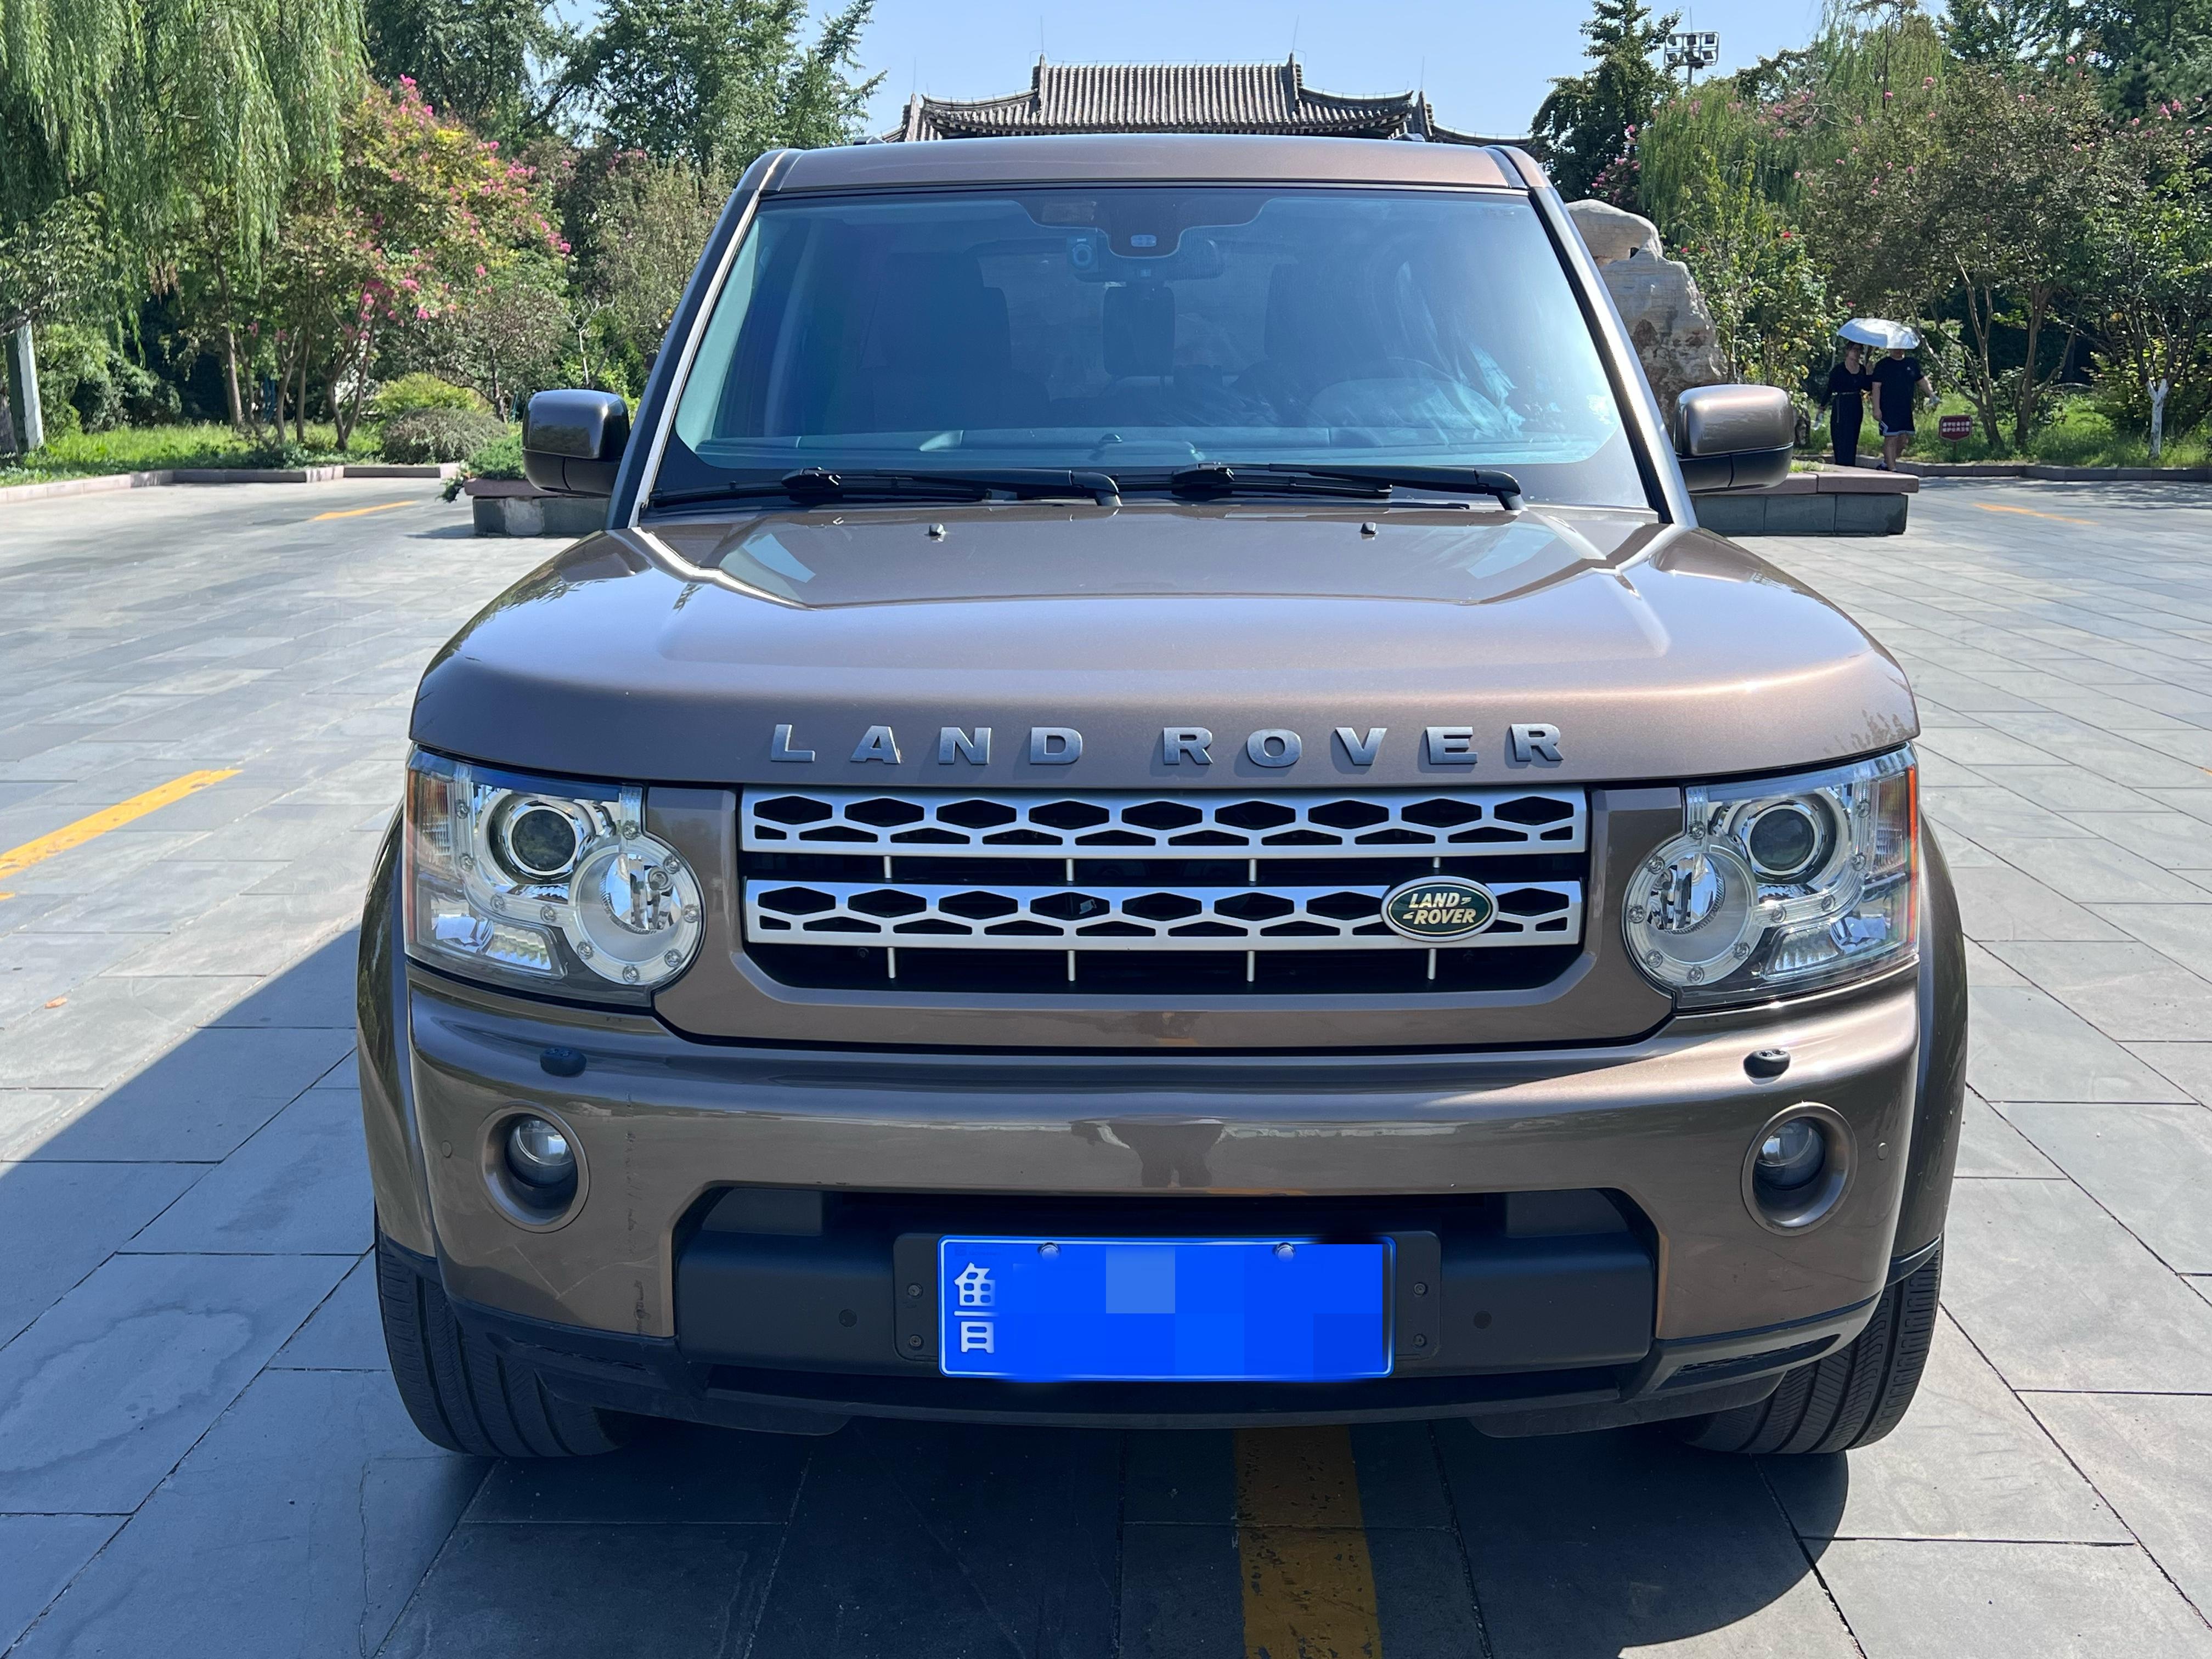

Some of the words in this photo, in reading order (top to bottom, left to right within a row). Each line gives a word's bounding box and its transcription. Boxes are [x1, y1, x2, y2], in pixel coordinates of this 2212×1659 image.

[771, 724, 1083, 765] LAND
[1163, 723, 1564, 767] ROVER
[1408, 893, 1460, 908] LAND
[1413, 909, 1476, 924] ROVER
